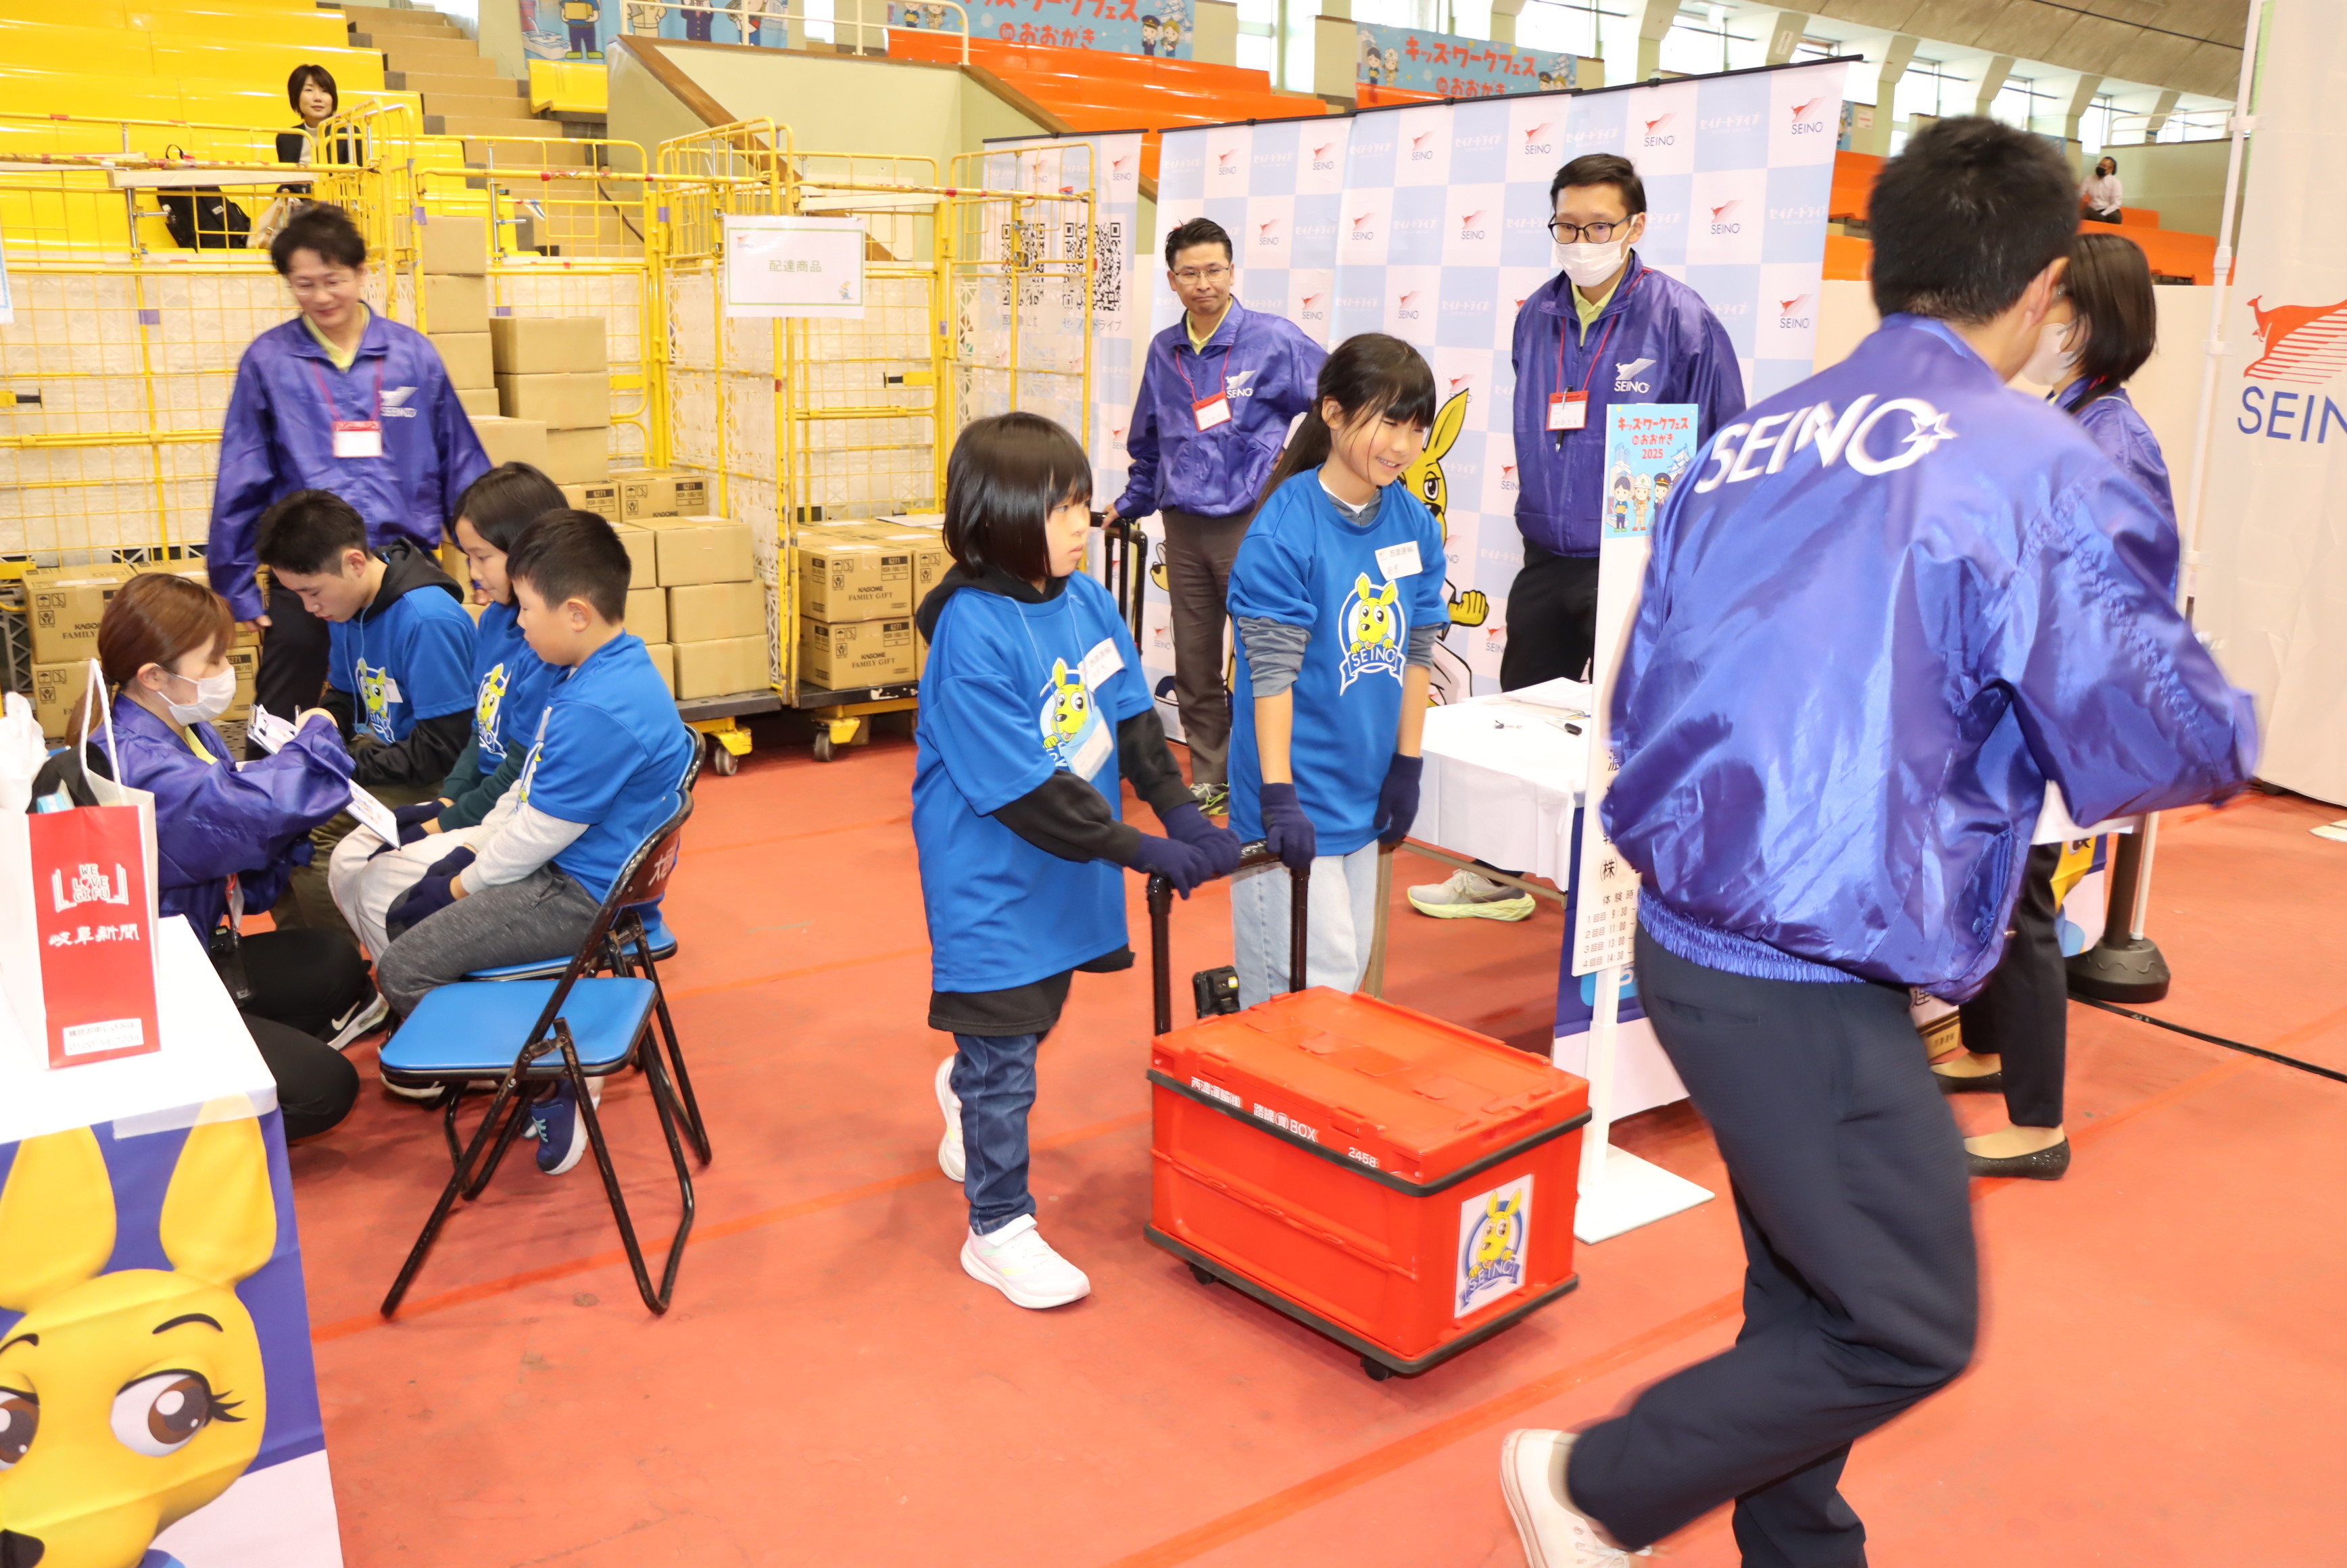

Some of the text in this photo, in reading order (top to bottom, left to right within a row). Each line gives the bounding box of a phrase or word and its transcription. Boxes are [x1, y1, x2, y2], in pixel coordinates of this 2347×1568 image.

[1406, 36, 1537, 77] キッズワークフェス
[1791, 122, 1824, 135] SEINO
[1643, 135, 1675, 147] SEINO
[1411, 150, 1433, 161] SEINO
[1524, 144, 1551, 155] SEINO
[1218, 166, 1236, 176] SEINO
[1312, 161, 1334, 171] SEINO
[1113, 172, 1132, 181] SEINO
[1461, 230, 1485, 240] SEINO
[1710, 223, 1741, 235] SEINO
[1259, 237, 1278, 245] SEINO
[1352, 231, 1374, 241] SEINO
[769, 260, 822, 272] 配達商品
[1302, 311, 1323, 320] SEINO
[1398, 310, 1420, 320] SEINO
[1779, 318, 1810, 329] SEINO
[1226, 388, 1255, 399] SEINO
[1614, 381, 1651, 394] SEINO
[1618, 417, 1689, 431] キッズワークフェス
[1641, 433, 1673, 445] おおがき
[1693, 394, 1958, 494] SEINO
[1642, 449, 1664, 459] 2025
[1501, 479, 1520, 491] SEIN
[62, 631, 96, 639] FAMILY
[1486, 642, 1505, 654] SEIN
[852, 658, 896, 668] FAMILY GIFT
[1352, 647, 1397, 667] SEINO
[79, 864, 98, 877] WE
[74, 888, 110, 902] GIFU
[49, 923, 140, 947] 岐阜新聞
[1348, 1147, 1378, 1168] 2458
[1468, 1258, 1514, 1292] SEINO
